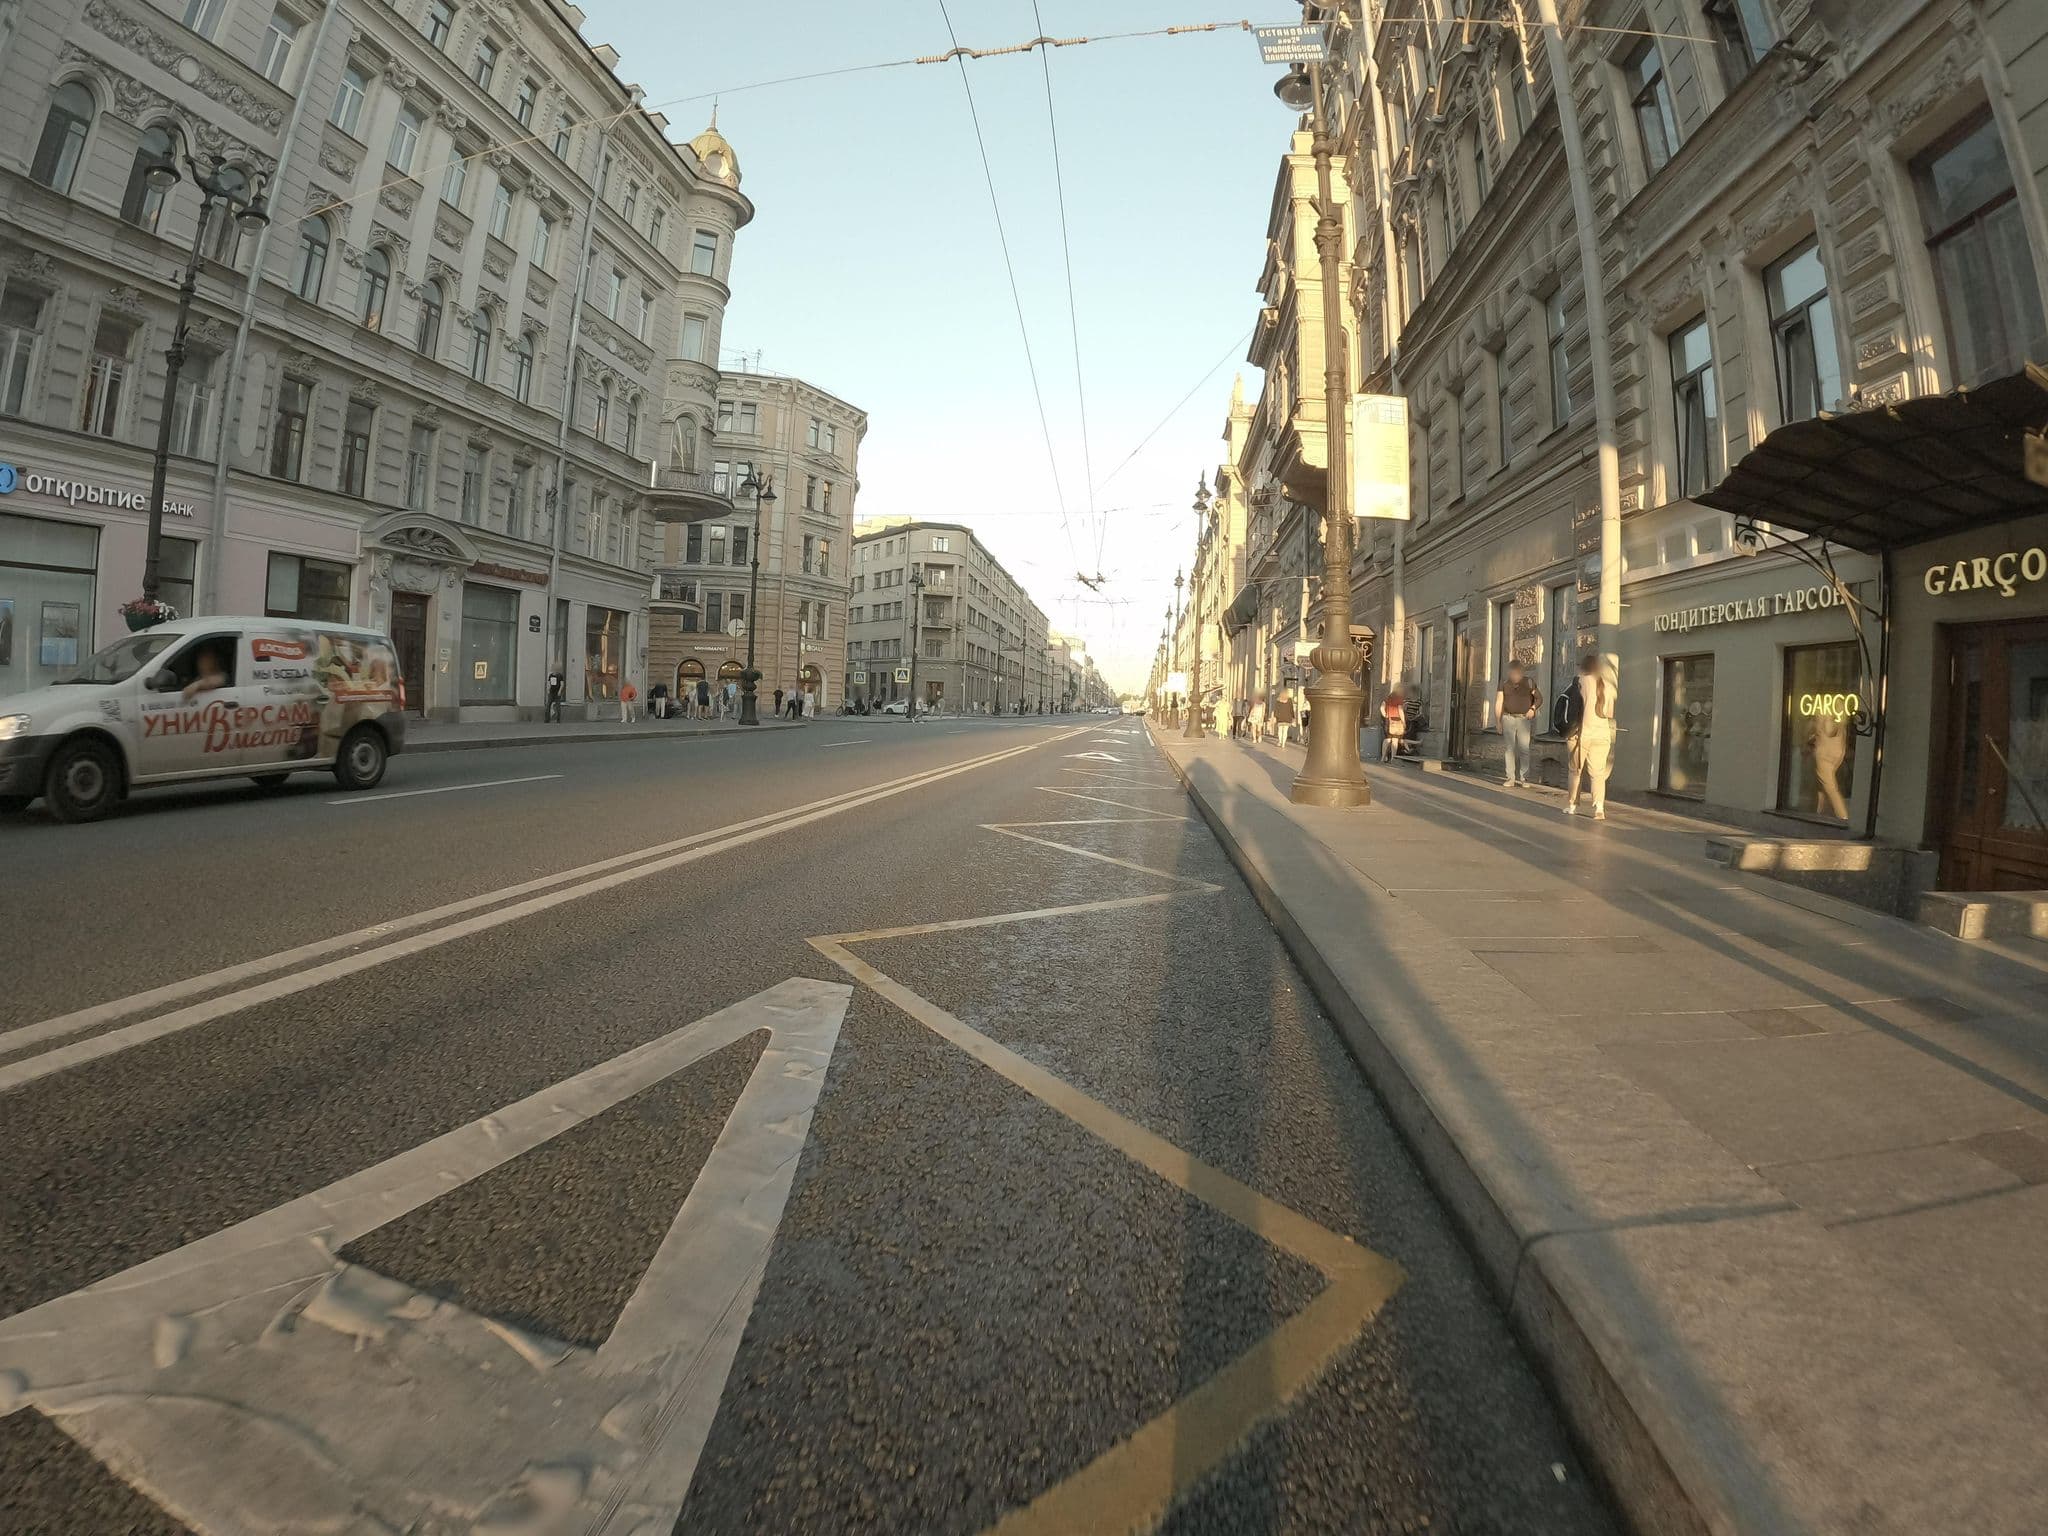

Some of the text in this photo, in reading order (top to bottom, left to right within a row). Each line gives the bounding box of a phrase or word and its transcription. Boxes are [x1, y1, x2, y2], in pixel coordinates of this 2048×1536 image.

[1263, 43, 1322, 54] ТРОЛЛЕЙБУСОВ
[26, 474, 194, 518] открытие БАНК
[1654, 596, 1767, 634] КОНДИТЕРСКАЯ
[143, 700, 312, 739] УНИВЕРСАМ
